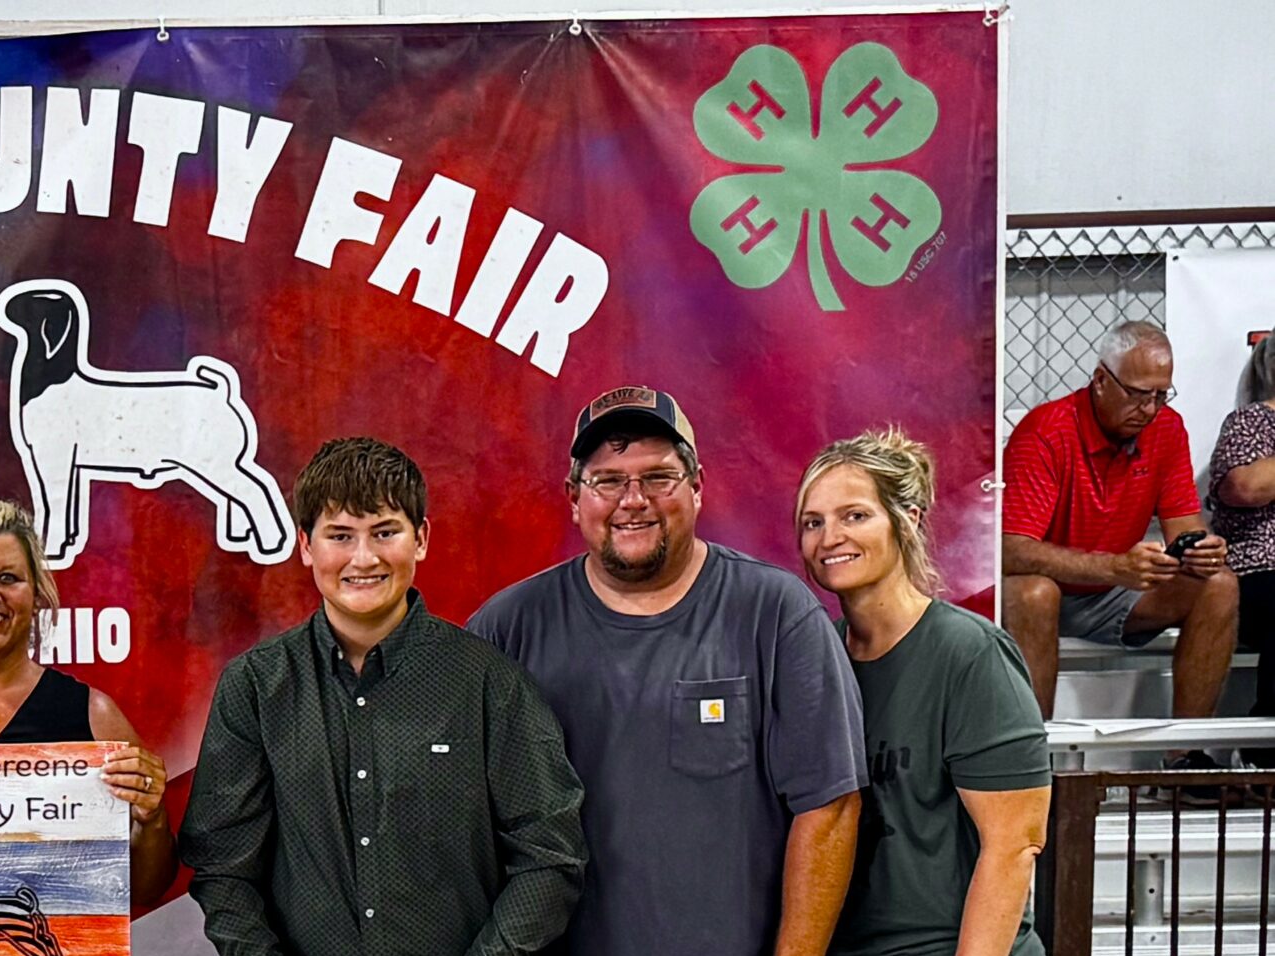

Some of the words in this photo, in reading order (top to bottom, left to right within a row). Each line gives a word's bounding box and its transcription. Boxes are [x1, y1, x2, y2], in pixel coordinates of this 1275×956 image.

[726, 79, 786, 141] H
[842, 76, 903, 138] H
[720, 195, 779, 255] H
[850, 192, 912, 253] H
[294, 136, 610, 378] FAIR
[28, 607, 131, 664] HIO
[26, 795, 84, 821] Fair
